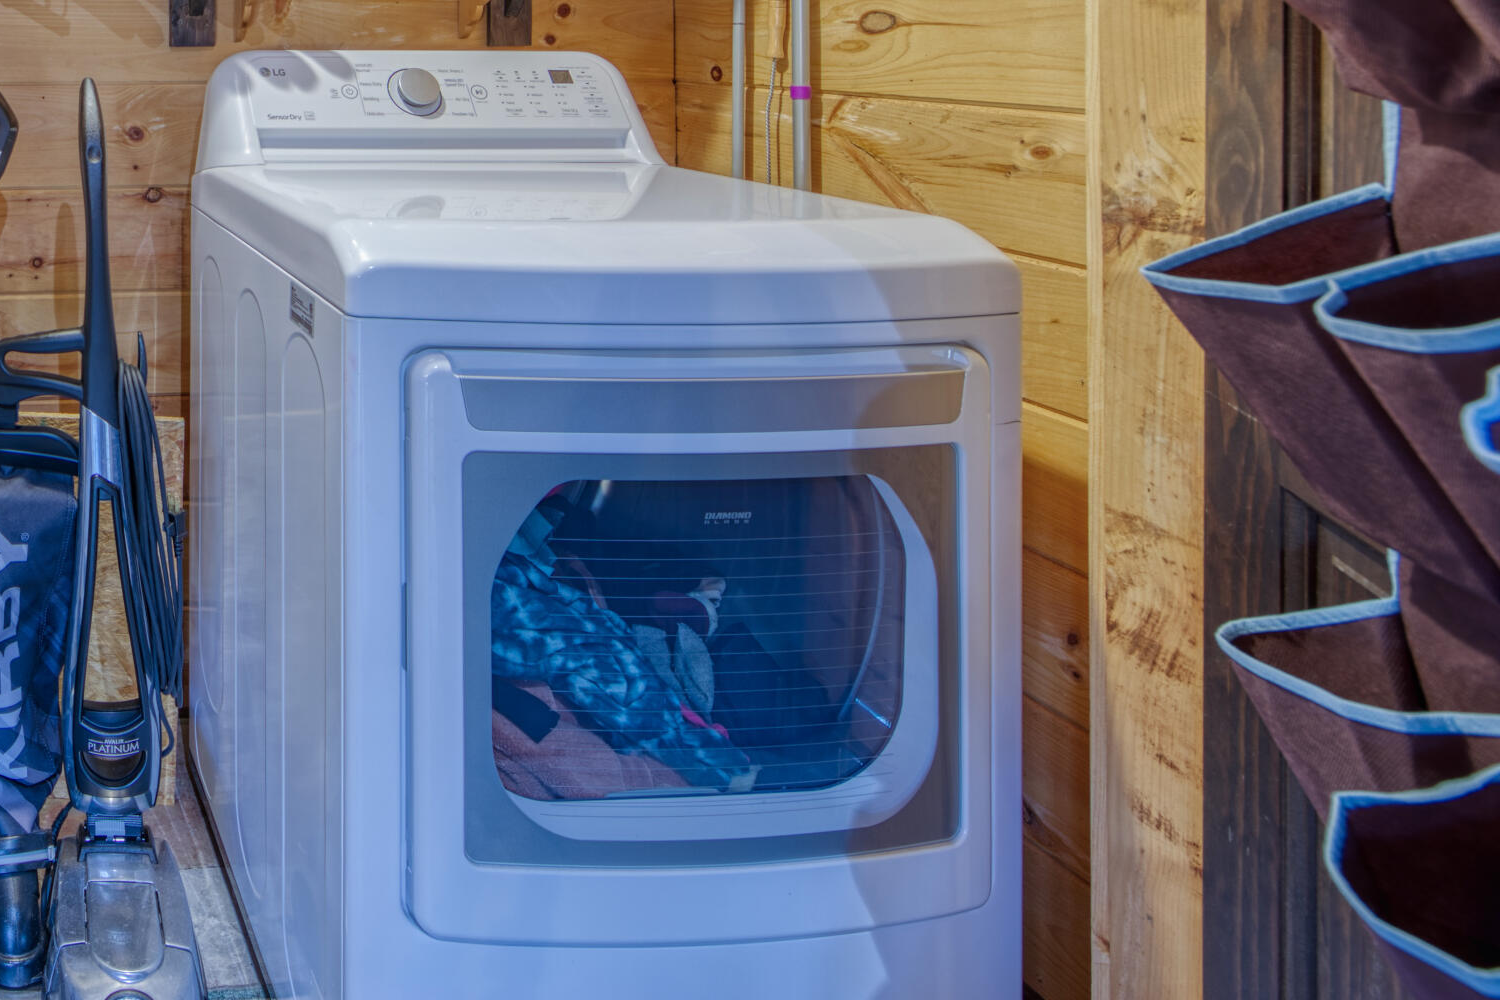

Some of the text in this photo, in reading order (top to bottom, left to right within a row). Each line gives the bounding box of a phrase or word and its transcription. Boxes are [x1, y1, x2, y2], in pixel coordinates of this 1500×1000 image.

[272, 68, 286, 77] LG
[704, 512, 752, 520] DIAMOND
[88, 741, 140, 754] PLATINUM
